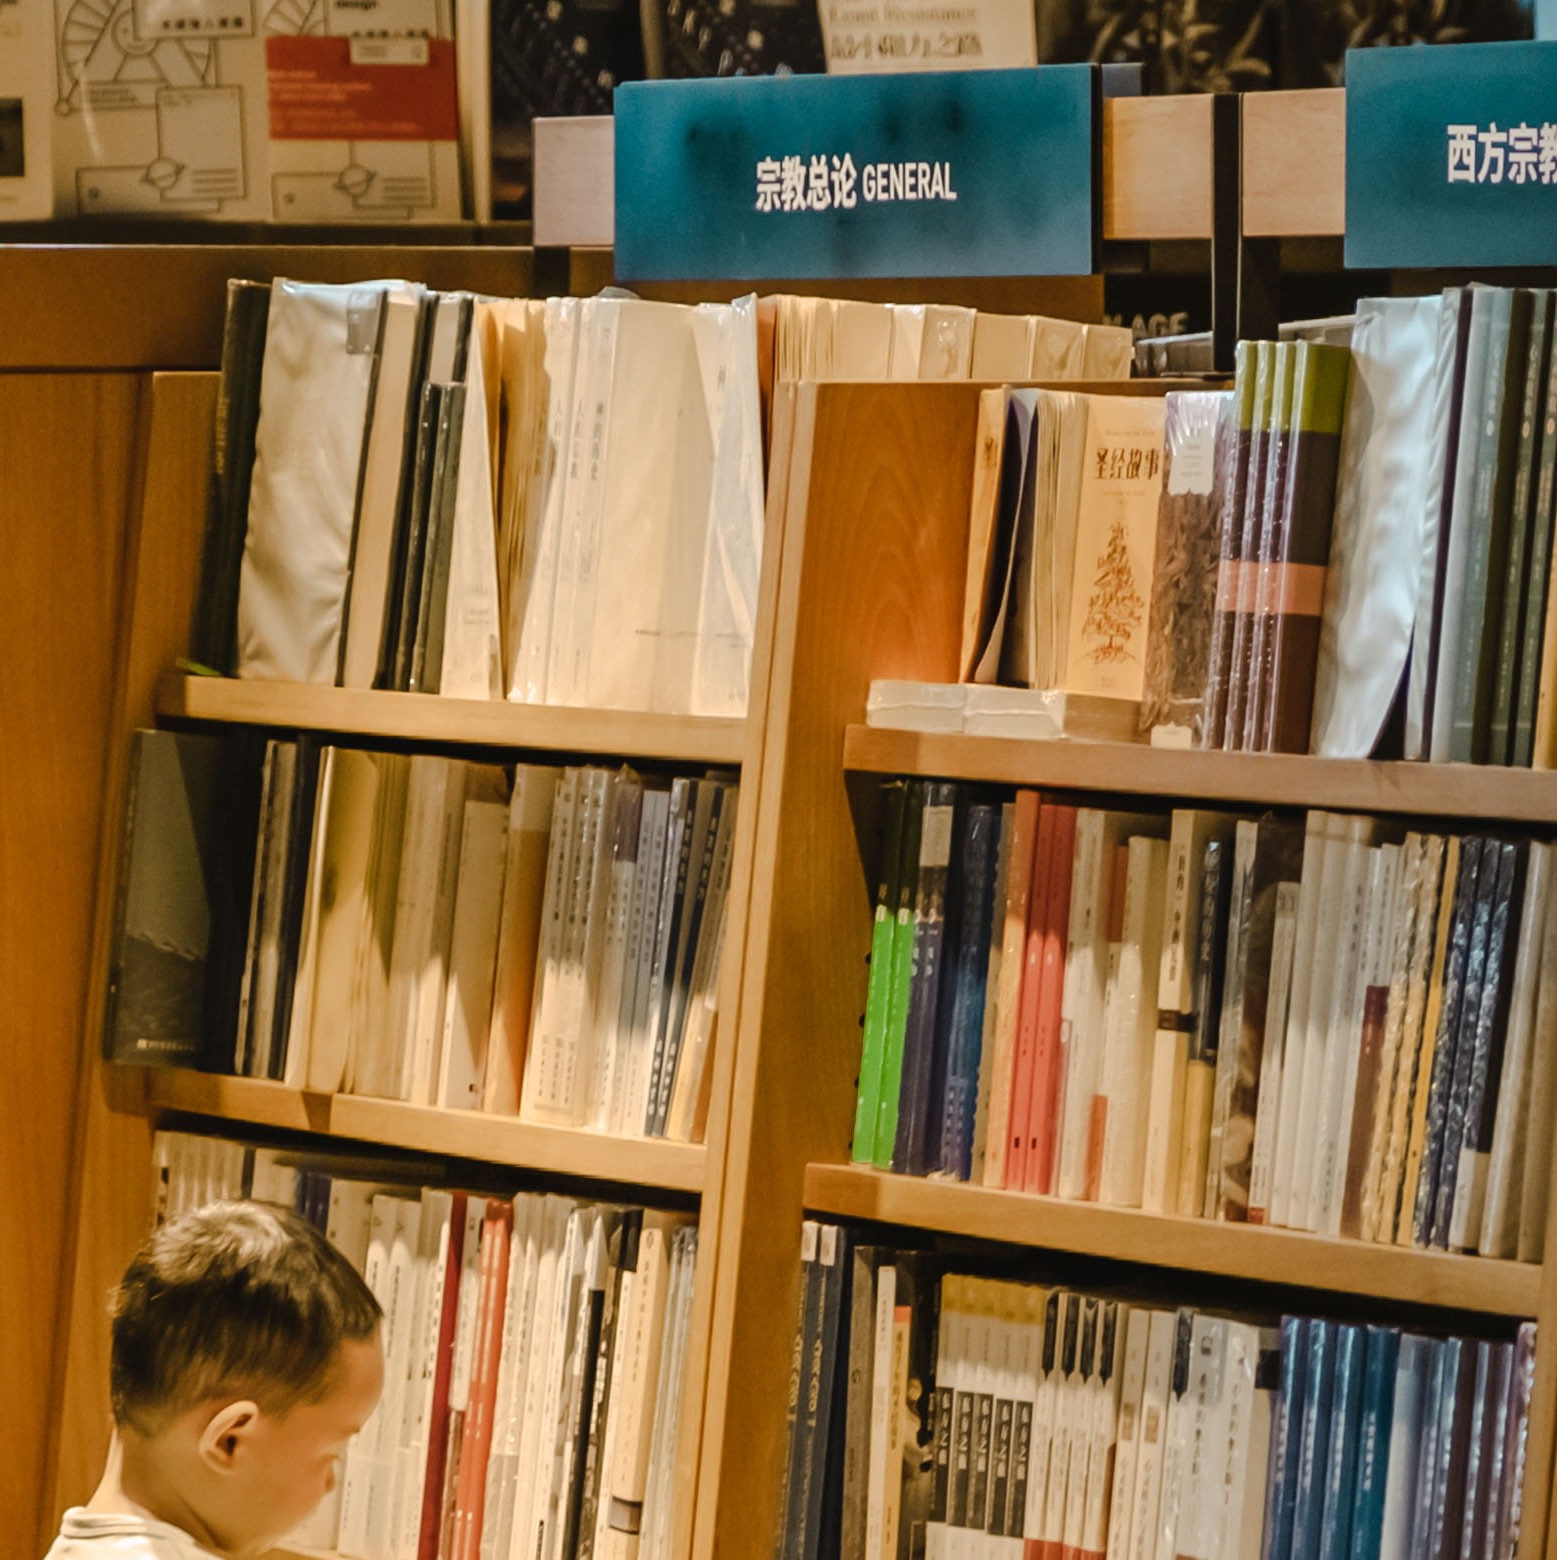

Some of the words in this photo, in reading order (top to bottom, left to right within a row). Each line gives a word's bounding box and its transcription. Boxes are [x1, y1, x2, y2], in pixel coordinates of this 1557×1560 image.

[755, 153, 858, 213] 宗教总论
[863, 161, 957, 201] GENERAL
[1093, 447, 1161, 480] 圣经故事
